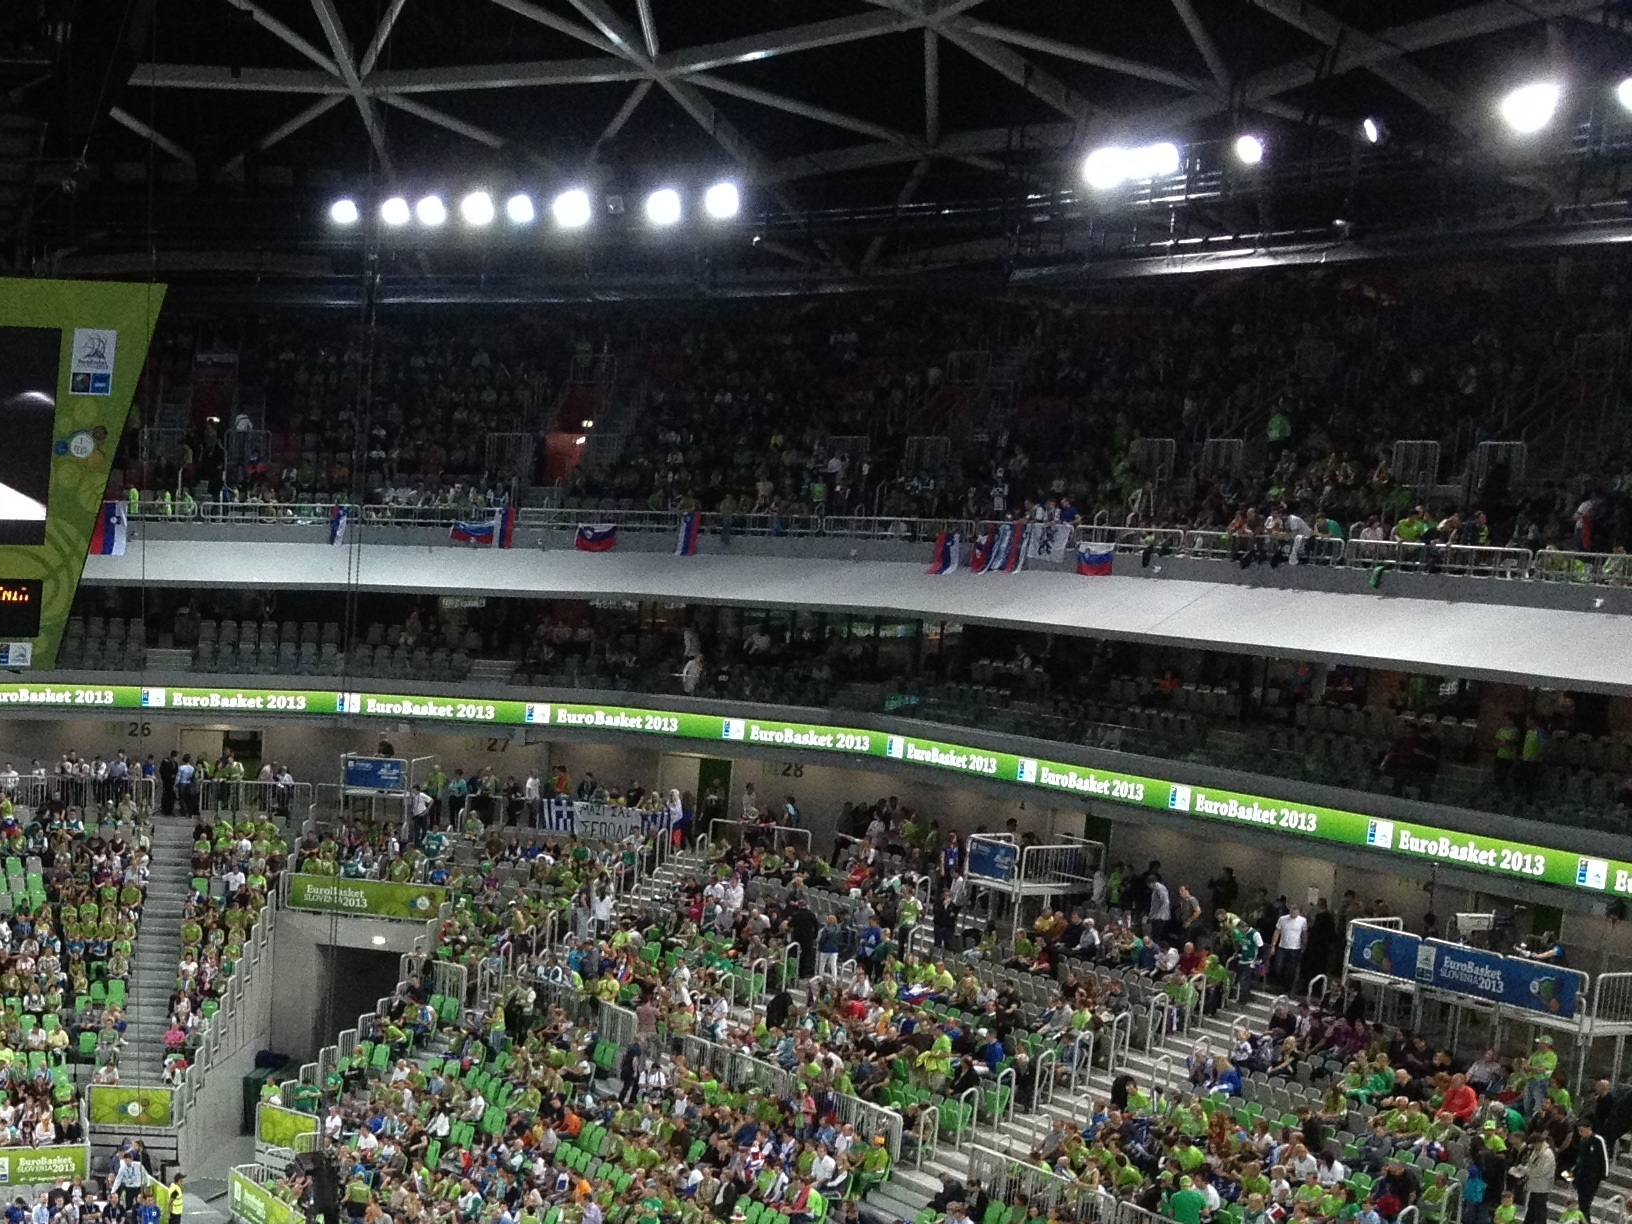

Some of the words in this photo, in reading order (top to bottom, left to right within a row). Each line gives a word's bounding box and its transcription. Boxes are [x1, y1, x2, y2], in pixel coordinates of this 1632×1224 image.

[75, 689, 115, 706] 2013
[172, 691, 261, 709] EuroBasket
[265, 694, 307, 710] 2013
[366, 698, 450, 719] EuroBasket
[455, 703, 496, 720] 2013
[128, 722, 152, 737] 26
[555, 707, 643, 729] EuroBasket
[646, 714, 680, 733] 2013
[487, 738, 510, 753] 27
[749, 725, 832, 748] EuroBasket
[835, 732, 872, 752] 2013
[906, 743, 968, 770] EuroBasket
[970, 754, 999, 774] 2013
[782, 762, 804, 778] 28
[1039, 767, 1109, 796] EuroBasket
[1111, 778, 1146, 802] 2013
[1195, 793, 1278, 826] EuroBasket
[1281, 807, 1319, 833] 2013
[1398, 830, 1498, 866] EuroBasket
[1501, 848, 1547, 876] 2013
[306, 884, 364, 900] EuroBasket
[343, 896, 367, 908] 2013
[1443, 956, 1502, 981] EuroBasket
[1440, 968, 1479, 985] SLOVENIA
[1478, 979, 1504, 993] 2013
[19, 1156, 72, 1166] EuroBasket
[52, 1163, 75, 1172] 2013
